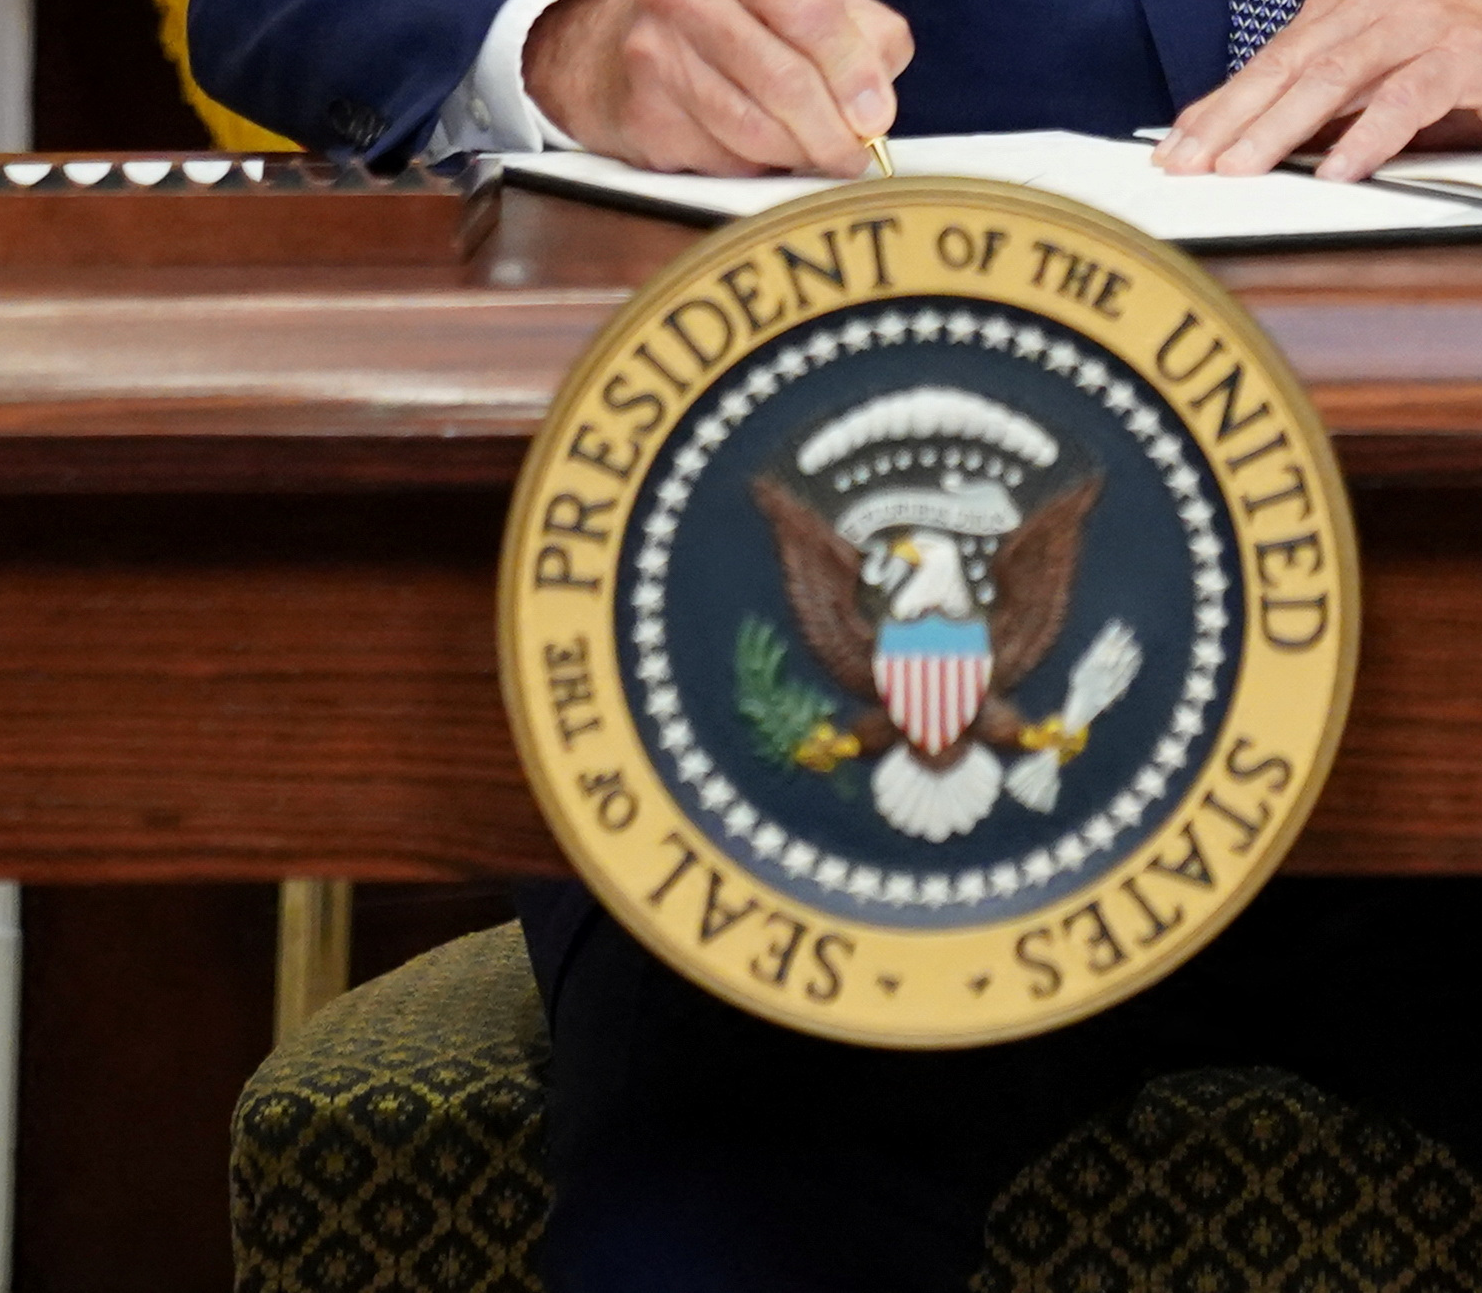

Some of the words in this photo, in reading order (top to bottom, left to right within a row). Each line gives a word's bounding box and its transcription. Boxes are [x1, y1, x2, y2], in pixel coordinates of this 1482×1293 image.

[935, 225, 1009, 275] OF
[1030, 240, 1132, 319] THE
[532, 215, 901, 595] PRESIDENT
[1154, 308, 1330, 654] UNITED
[542, 636, 602, 751] THE
[577, 770, 639, 832] OF
[1014, 736, 1293, 1000] STATES
[646, 831, 856, 1004] SEAL
